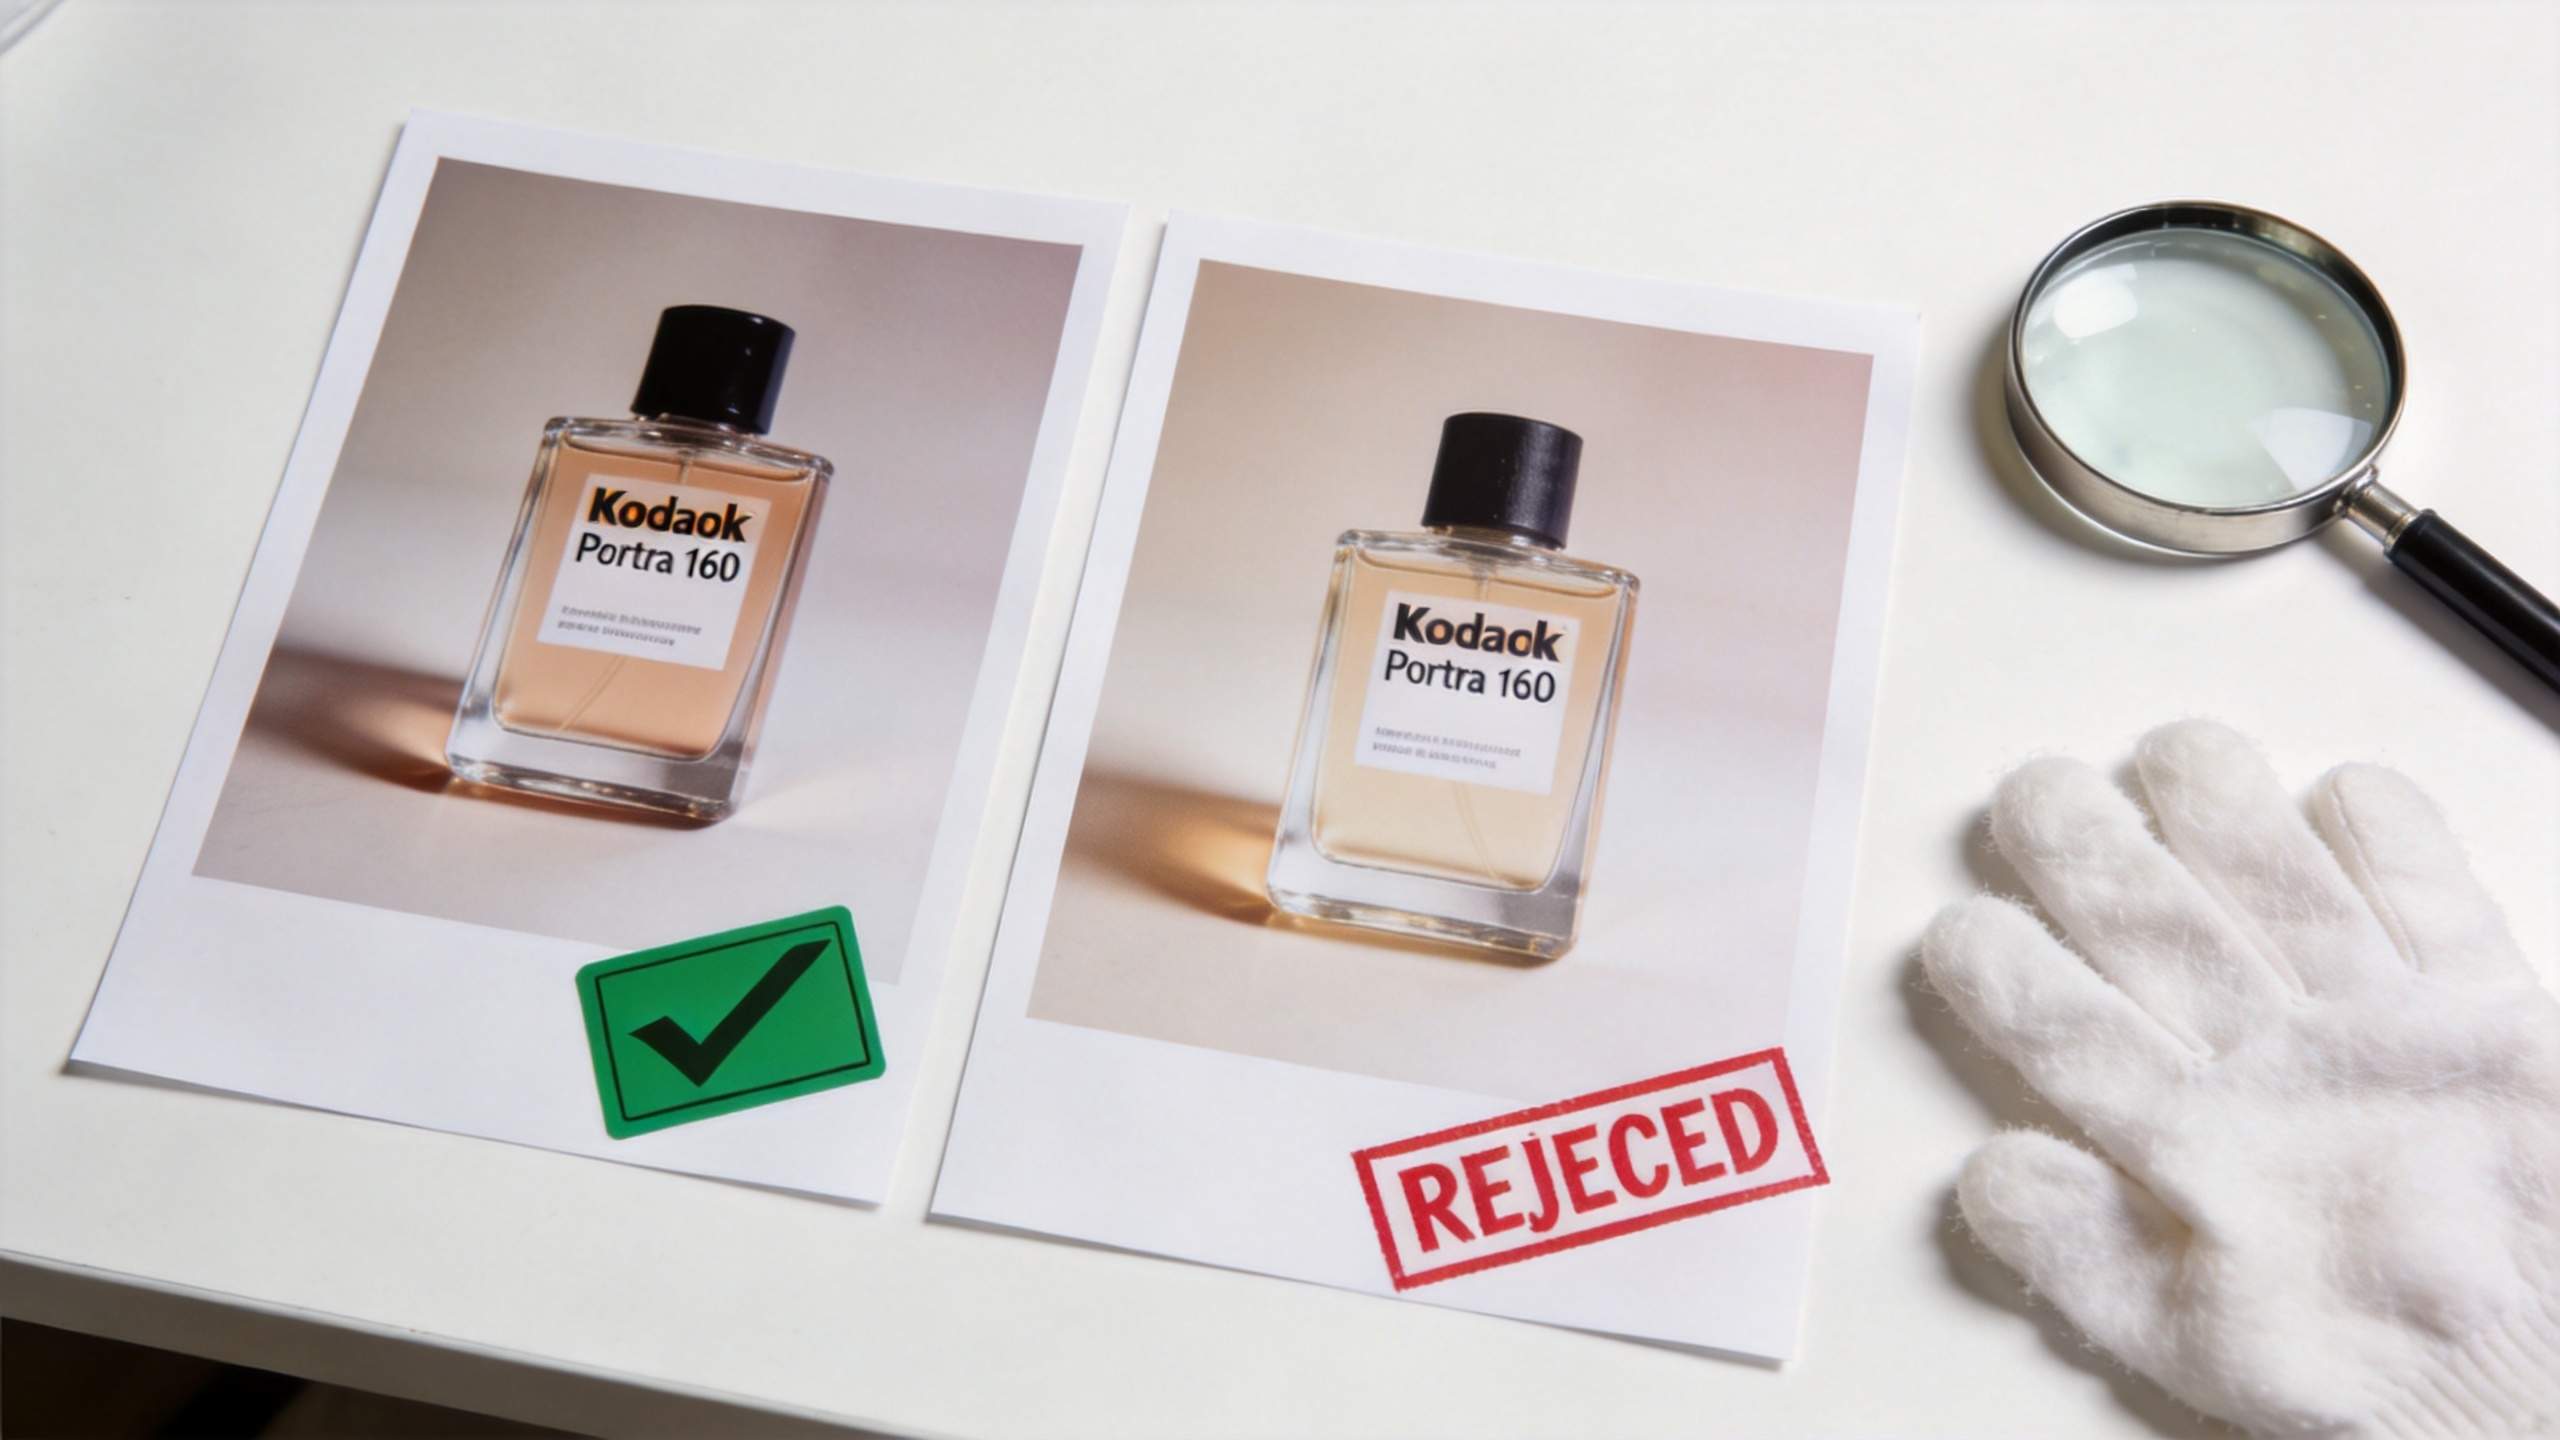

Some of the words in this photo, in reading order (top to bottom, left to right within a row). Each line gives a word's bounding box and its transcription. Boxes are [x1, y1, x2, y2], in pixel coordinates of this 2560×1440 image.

[587, 486, 752, 542] Kodaok
[575, 532, 674, 574] Portra
[685, 547, 740, 582] 160
[1393, 602, 1564, 662] Kodaok
[1384, 649, 1486, 694] Portra
[1498, 668, 1555, 703] 160
[1398, 1088, 1778, 1253] REJECED
